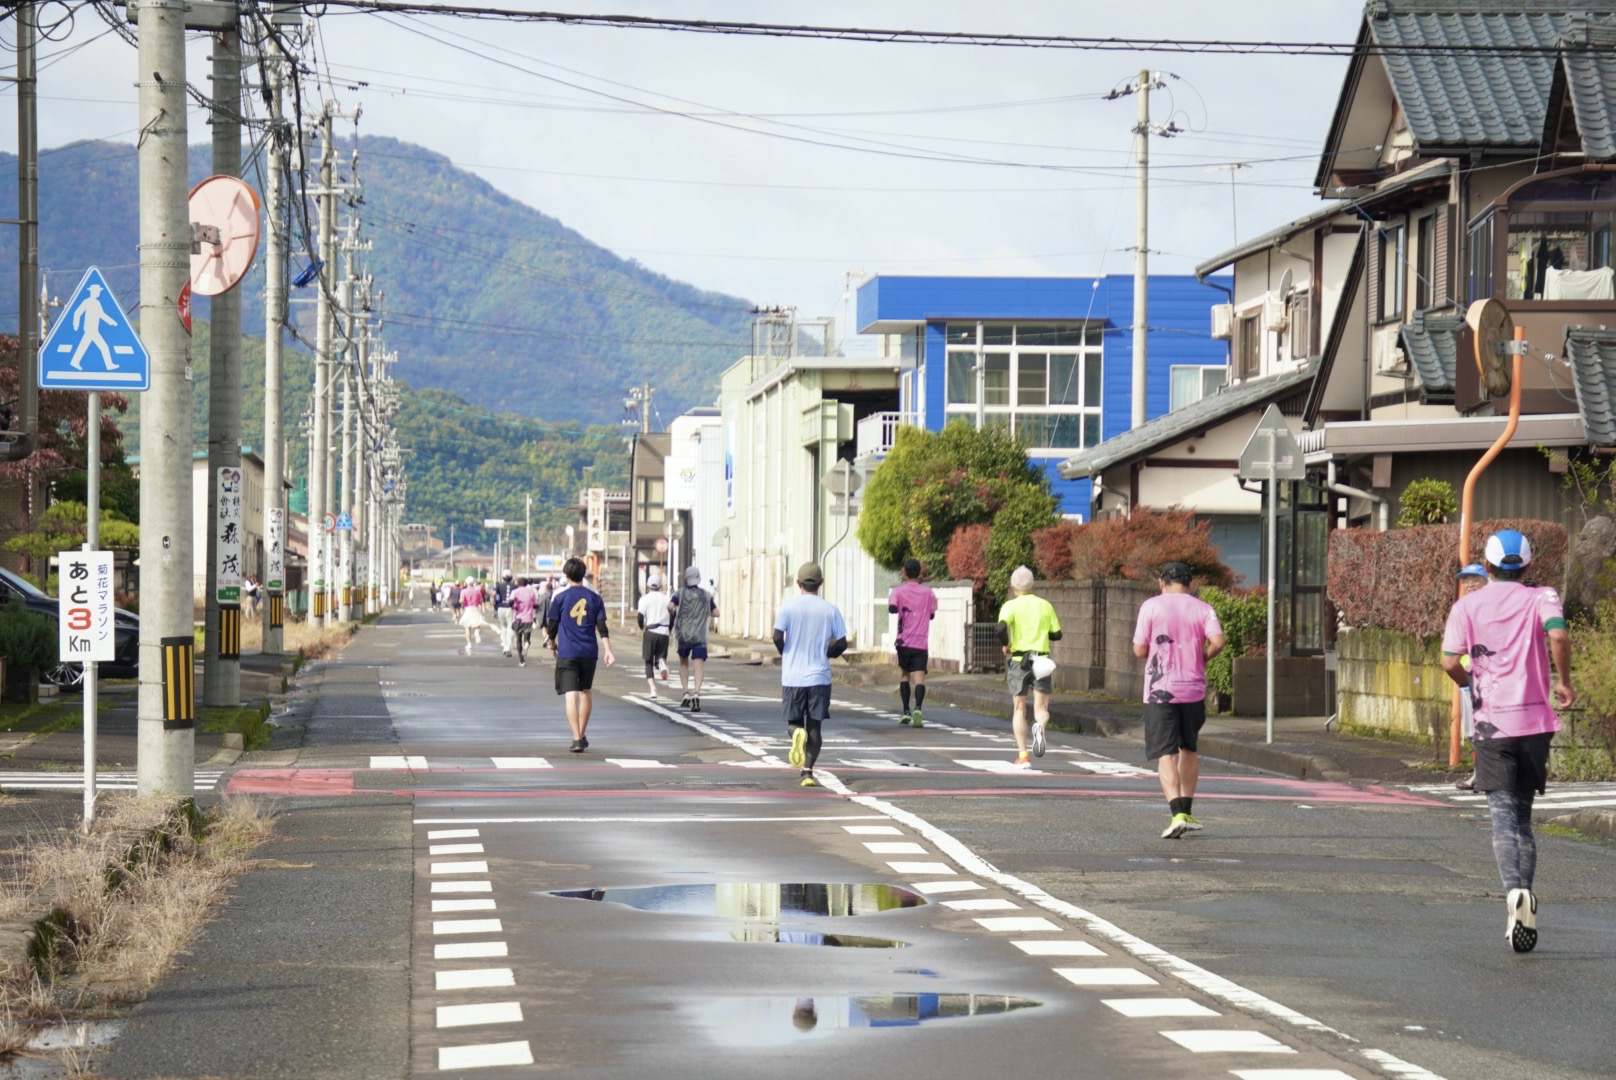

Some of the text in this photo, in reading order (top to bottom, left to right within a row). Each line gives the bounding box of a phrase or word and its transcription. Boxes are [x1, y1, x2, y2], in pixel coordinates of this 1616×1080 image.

[97, 564, 108, 640] 菊花マラソン
[570, 598, 587, 626] 4
